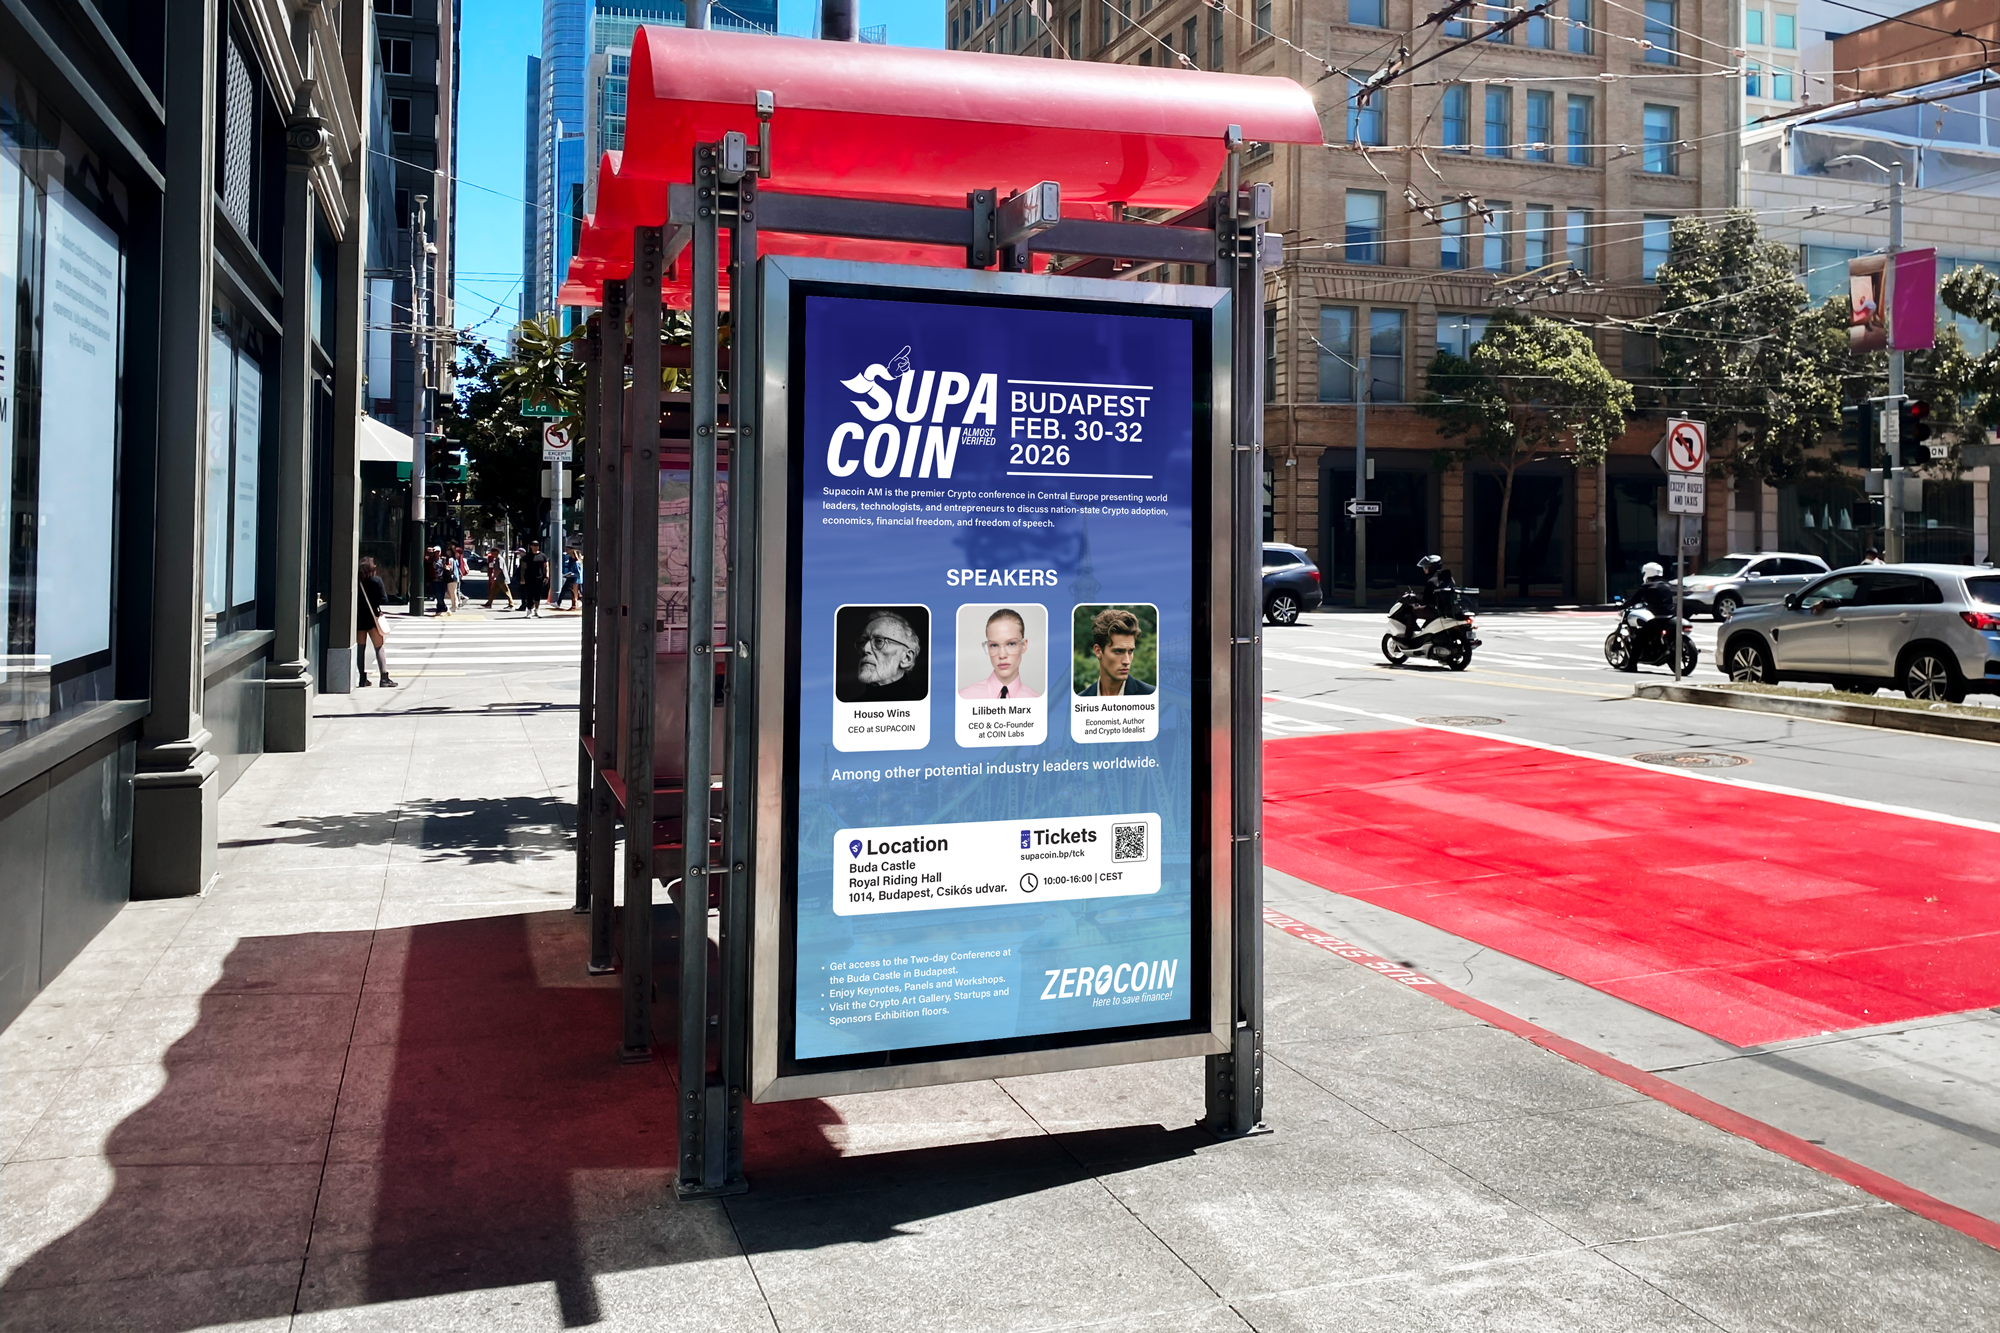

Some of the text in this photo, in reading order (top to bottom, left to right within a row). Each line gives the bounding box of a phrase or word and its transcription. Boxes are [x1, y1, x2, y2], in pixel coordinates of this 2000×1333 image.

[840, 363, 998, 425] SUPA
[1011, 391, 1151, 418] BUDAPEST
[962, 428, 994, 437] ALMOST
[1011, 417, 1142, 442] FEB. 30-32
[961, 437, 997, 446] VERIFIED
[826, 422, 962, 479] COIN
[1010, 444, 1070, 466] 2026
[823, 487, 865, 497] Supacoin
[867, 488, 882, 496] AM
[895, 488, 909, 497] the
[911, 490, 945, 498] premier
[947, 490, 976, 499] Crypto
[978, 490, 1025, 499] conference
[1037, 491, 1068, 500] Central
[1070, 492, 1099, 502] Europe
[1101, 494, 1143, 503] presenting
[1145, 494, 1167, 502] world
[1670, 481, 1703, 494] EXCEPT BUSES
[823, 501, 858, 511] leaders,
[861, 502, 923, 513] technologists,
[925, 503, 942, 511] and
[944, 504, 1005, 513] entrepreneurs
[1017, 505, 1049, 513] discuss
[1051, 506, 1100, 514] nation-state
[1102, 506, 1129, 516] Crypto
[1131, 507, 1168, 516] adoption,
[1674, 495, 1698, 507] AND TAXIS
[822, 516, 1055, 529] economics, financial freedom, and freedom of speech.
[946, 569, 1058, 586] SPEAKERS
[854, 709, 910, 718] Houso Wins
[972, 706, 1031, 715] Lilibeth Marx
[1075, 704, 1099, 712] Sirius
[968, 722, 984, 730] CEO
[994, 721, 1034, 729] Co-Founder
[1098, 727, 1121, 735] Crypto
[831, 756, 1159, 782] Among other potential industry leaders worldwide.
[1034, 828, 1097, 845] Tickets
[868, 836, 948, 855] Location
[1021, 849, 1085, 861] supacoin.bp/tck
[850, 860, 916, 873] Buda Castle
[849, 872, 941, 889] Royal Riding Hall
[1044, 874, 1092, 885] 10:00-16:00
[1100, 872, 1123, 881] CEST
[849, 883, 1007, 902] 1014, Budapest, Csikós udvar.
[1301, 933, 1374, 958] STOP
[830, 962, 846, 971] Get
[849, 960, 880, 969] access
[894, 957, 908, 965] the
[910, 954, 949, 964] Two-day
[951, 950, 1001, 961] Conference
[1003, 948, 1011, 956] at
[830, 966, 958, 984] the Buda Castle in Budapest.
[1040, 959, 1178, 1000] ZEROCOIN
[1365, 961, 1437, 985] BUS
[830, 976, 1005, 999] Enjoy Keynotes, Panels and Workshops.
[829, 987, 1009, 1011] Visit the Crypto Art Gallery, Startups and
[1092, 990, 1173, 1007] Here to save finance!
[829, 1007, 949, 1026] Sponsors Exhibition floors.
